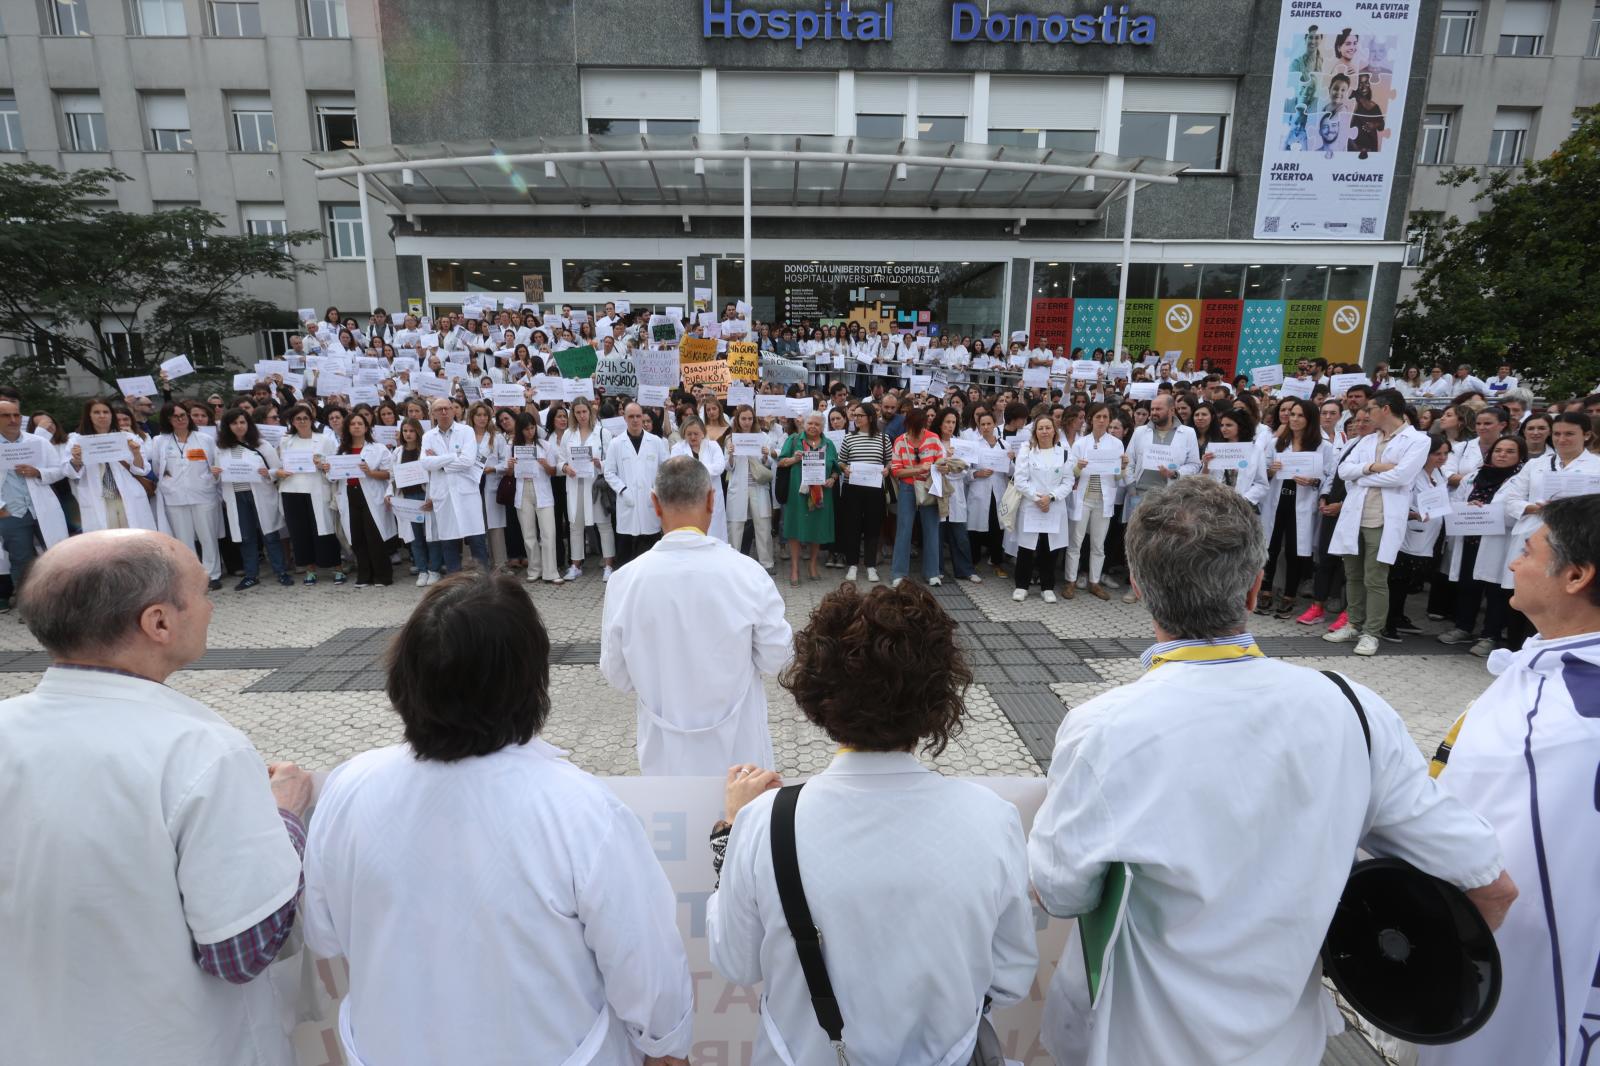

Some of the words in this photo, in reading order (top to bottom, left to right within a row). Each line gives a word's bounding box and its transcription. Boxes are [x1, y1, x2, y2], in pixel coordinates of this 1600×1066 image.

[1291, 1, 1323, 9] GRIPEA
[1355, 3, 1379, 11] PARA
[1380, 3, 1410, 11] EVITAR
[1290, 10, 1342, 18] SAIHESTEKO
[1383, 12, 1409, 20] GRIPE
[702, 0, 894, 49] Hospital
[951, 1, 1158, 45] Donostia
[1271, 163, 1300, 171] JARRI
[1270, 173, 1314, 181] TXERTOA
[1332, 172, 1384, 182] VACÚNATE
[784, 264, 828, 273] DONOSTIA
[829, 264, 893, 274] UNIBERTSITATE
[894, 265, 940, 274] OSPITALEA
[784, 274, 827, 283] HOSPITAL
[897, 275, 940, 284] DONOSTIA
[598, 360, 617, 373] 24h
